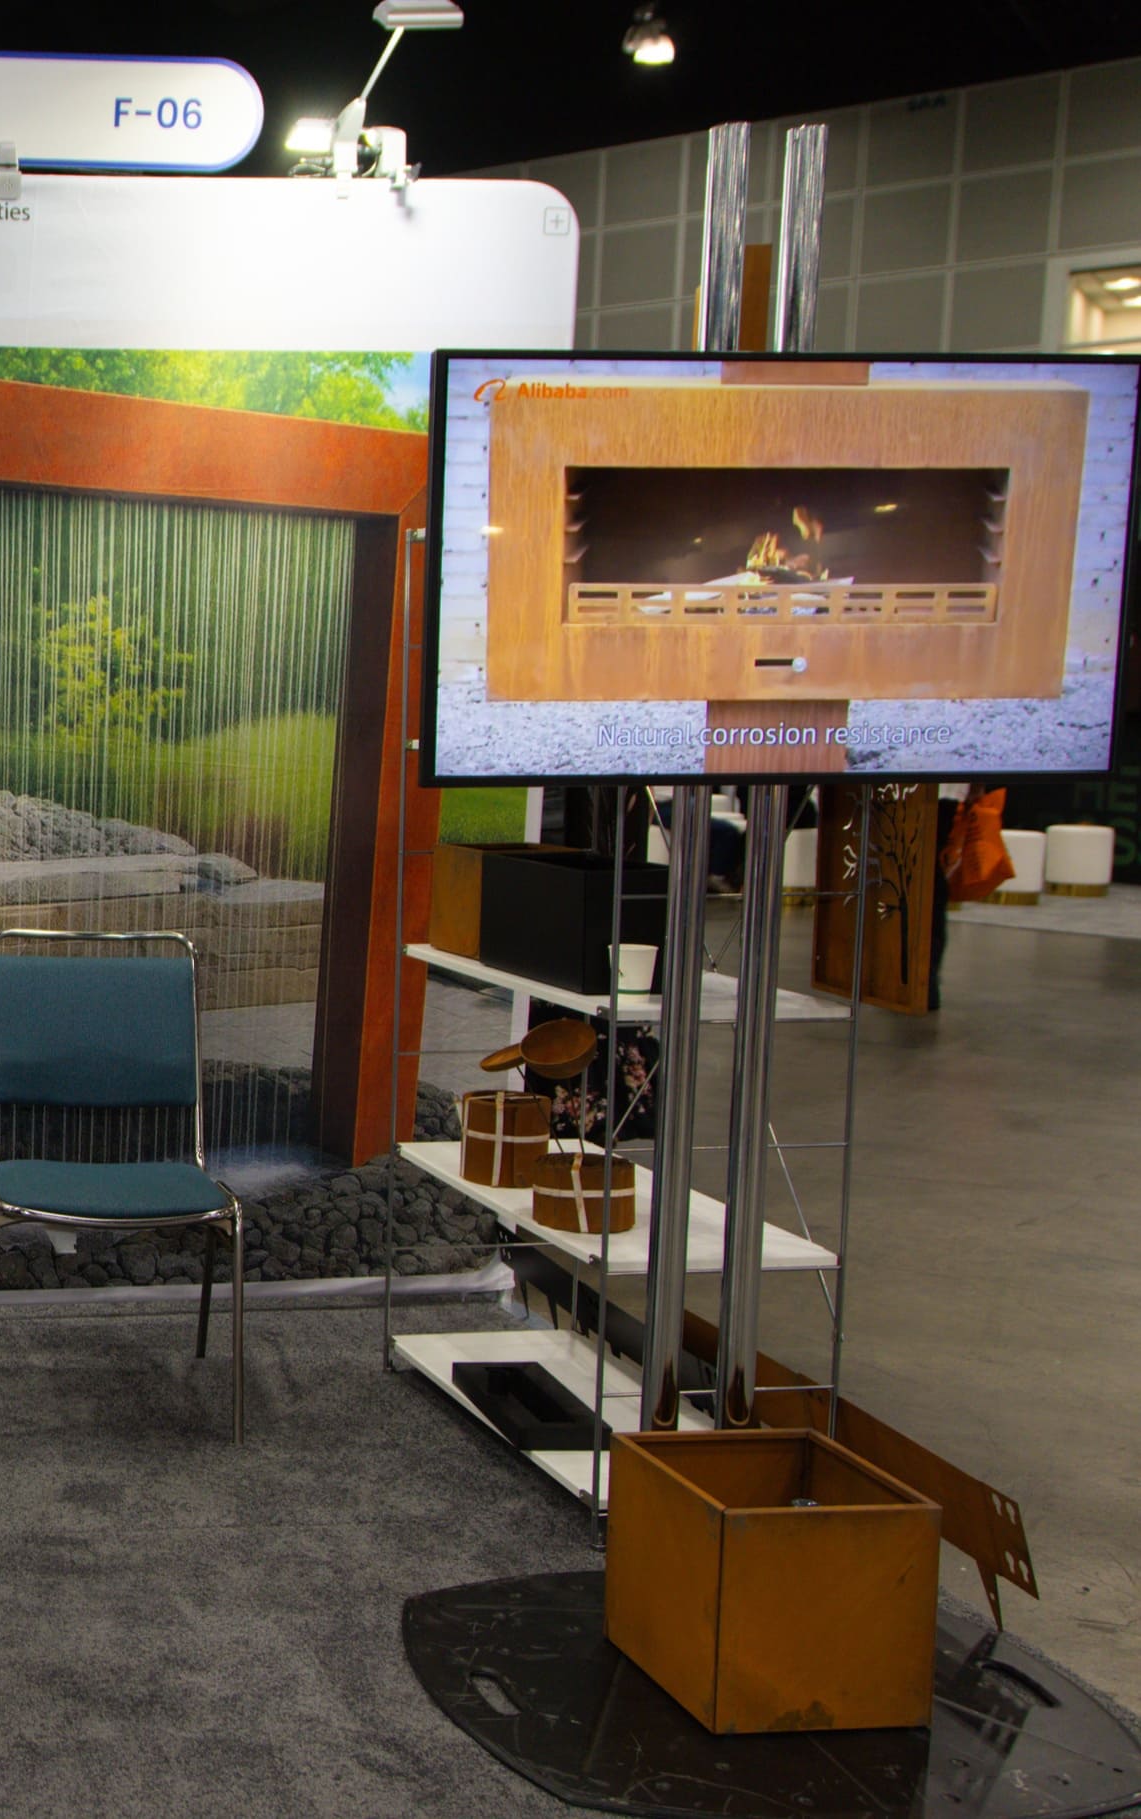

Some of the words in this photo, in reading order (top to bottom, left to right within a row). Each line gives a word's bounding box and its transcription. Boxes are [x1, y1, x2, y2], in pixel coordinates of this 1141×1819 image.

[113, 97, 202, 129] F-06
[518, 383, 629, 399] Alibaba.com
[597, 722, 693, 747] Natural
[700, 722, 817, 747] corrosion
[826, 722, 952, 746] resistance
